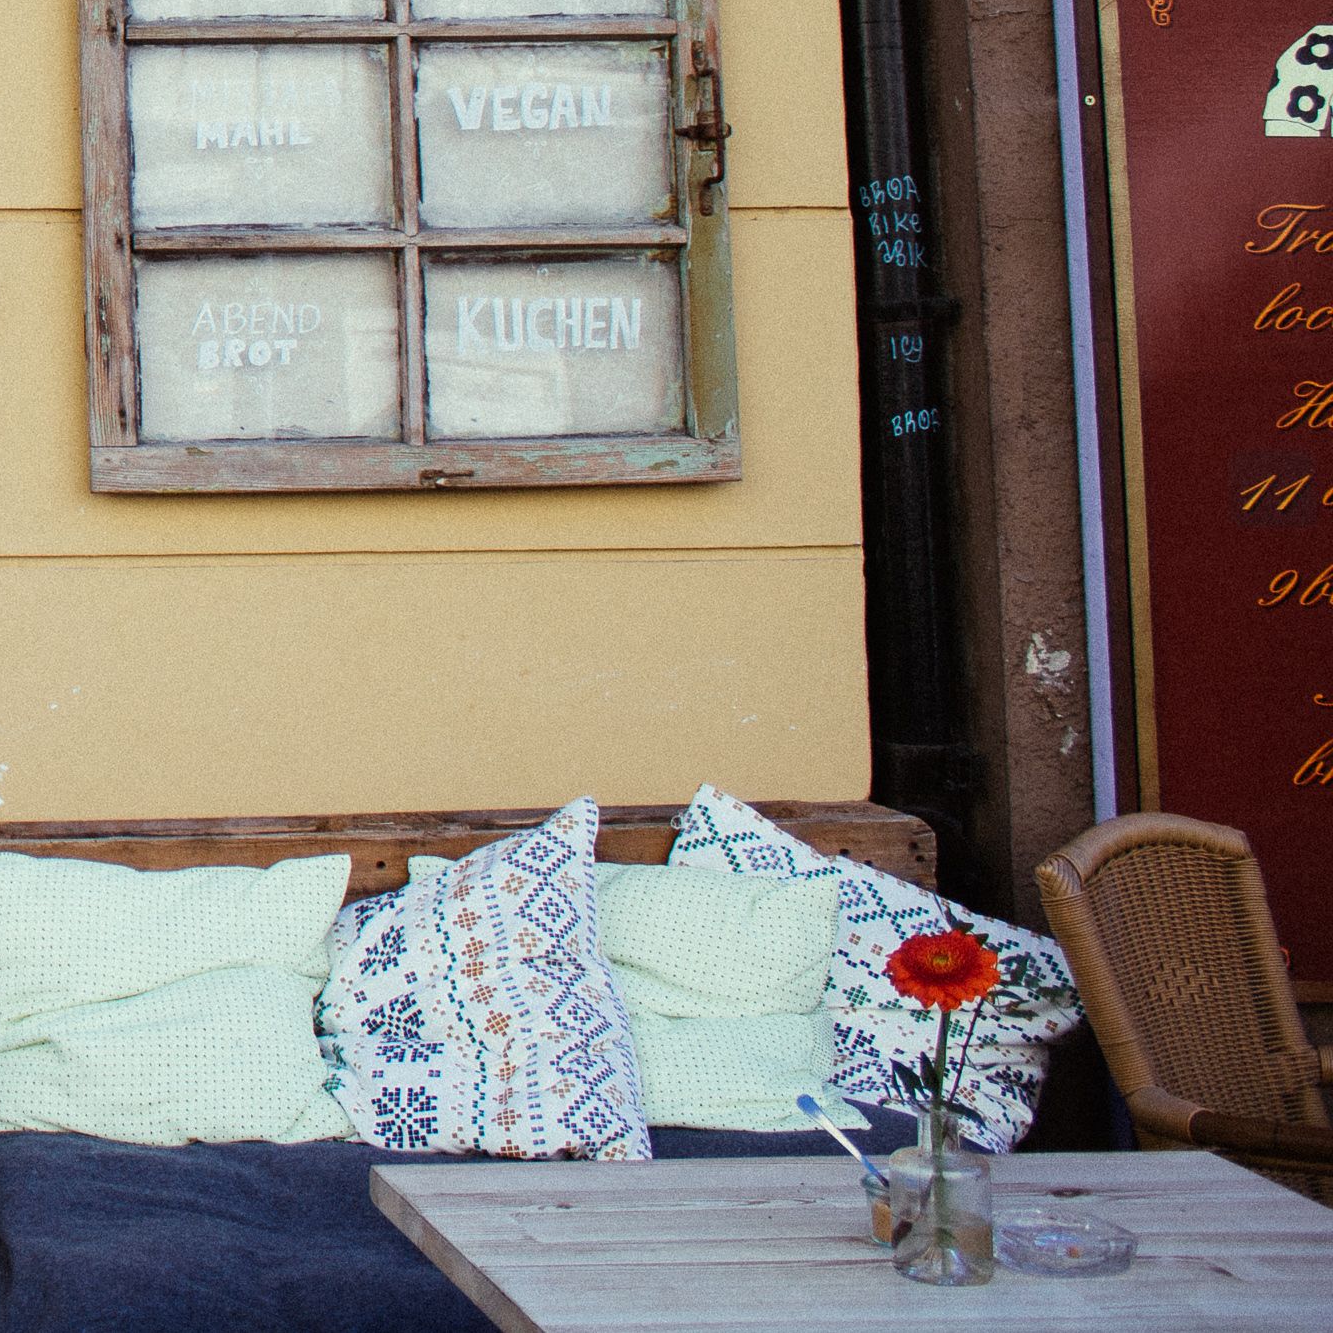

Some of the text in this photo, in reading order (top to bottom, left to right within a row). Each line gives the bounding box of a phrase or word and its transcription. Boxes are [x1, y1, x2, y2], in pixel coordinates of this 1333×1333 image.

[447, 82, 611, 131] VEGAN
[196, 122, 313, 150] MAHL
[192, 300, 322, 335] ABEND
[457, 296, 642, 356] KUCHEN
[197, 338, 298, 370] BROT
